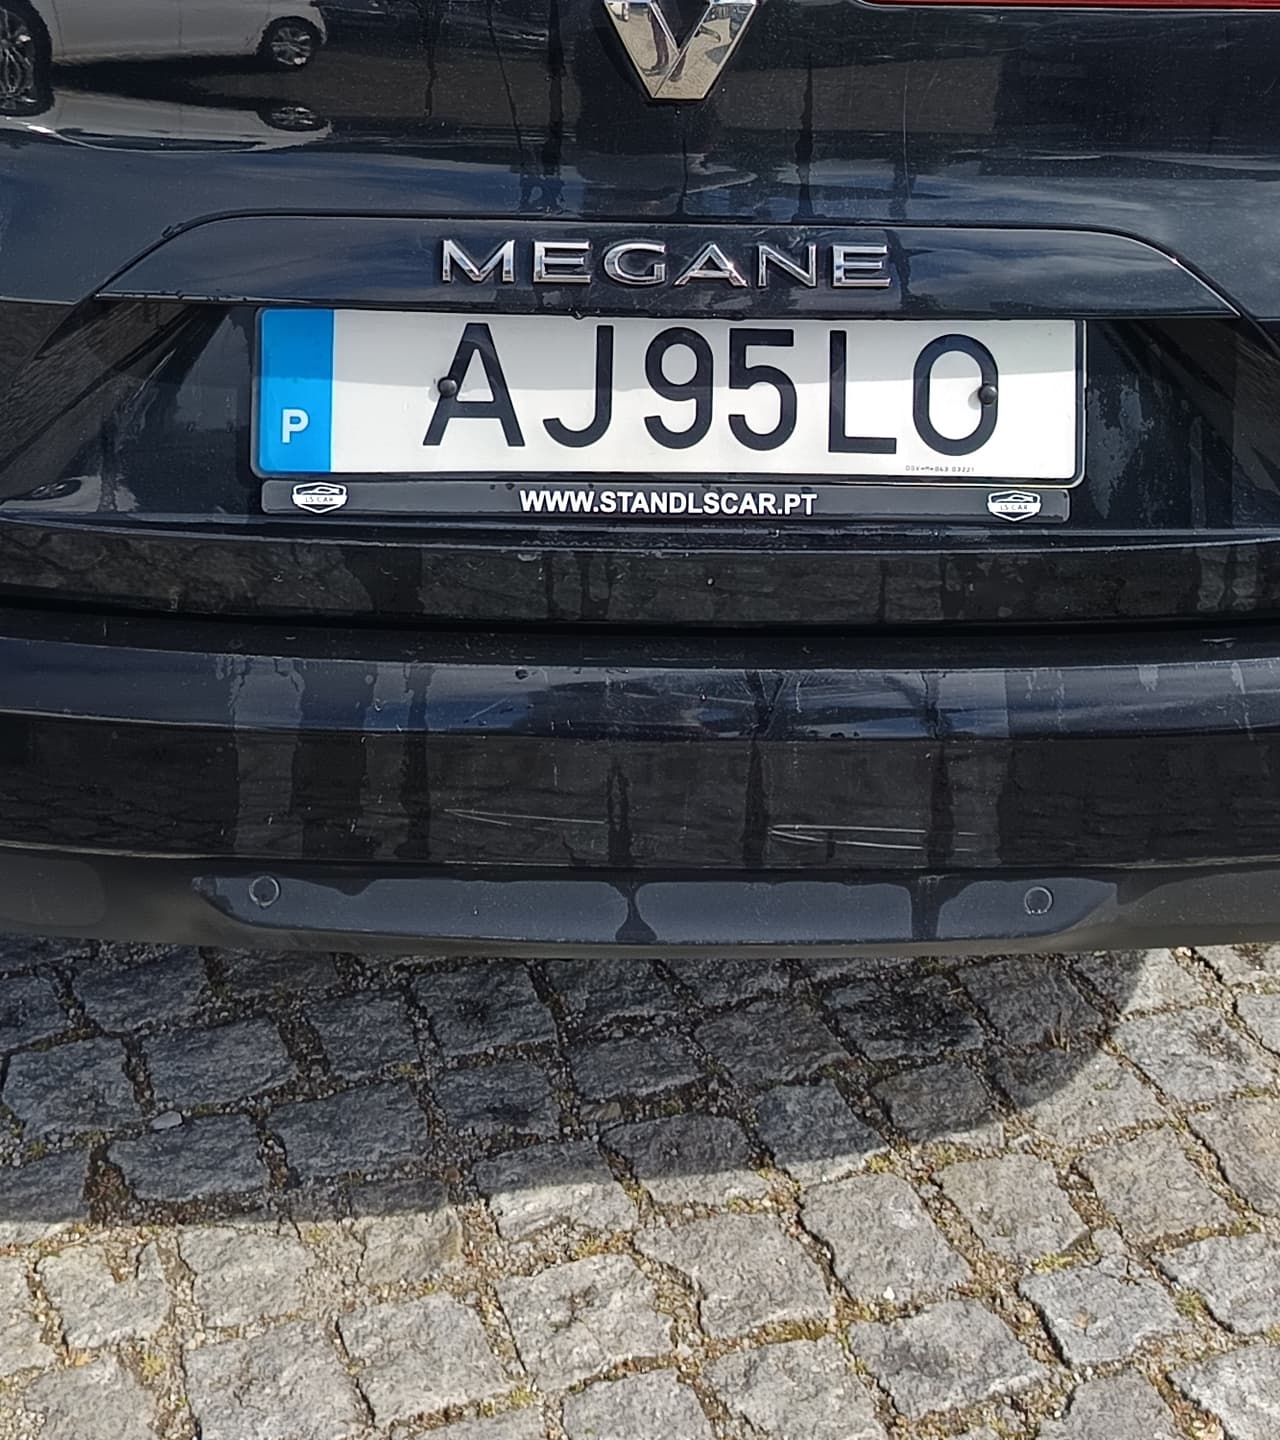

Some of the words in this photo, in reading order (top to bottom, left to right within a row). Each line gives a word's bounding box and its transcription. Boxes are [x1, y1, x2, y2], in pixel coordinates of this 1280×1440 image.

[441, 238, 892, 288] MEGANE
[281, 408, 309, 444] P
[422, 322, 999, 457] AJ95LO
[519, 489, 818, 516] WWW.STANDLSCAR.PT
